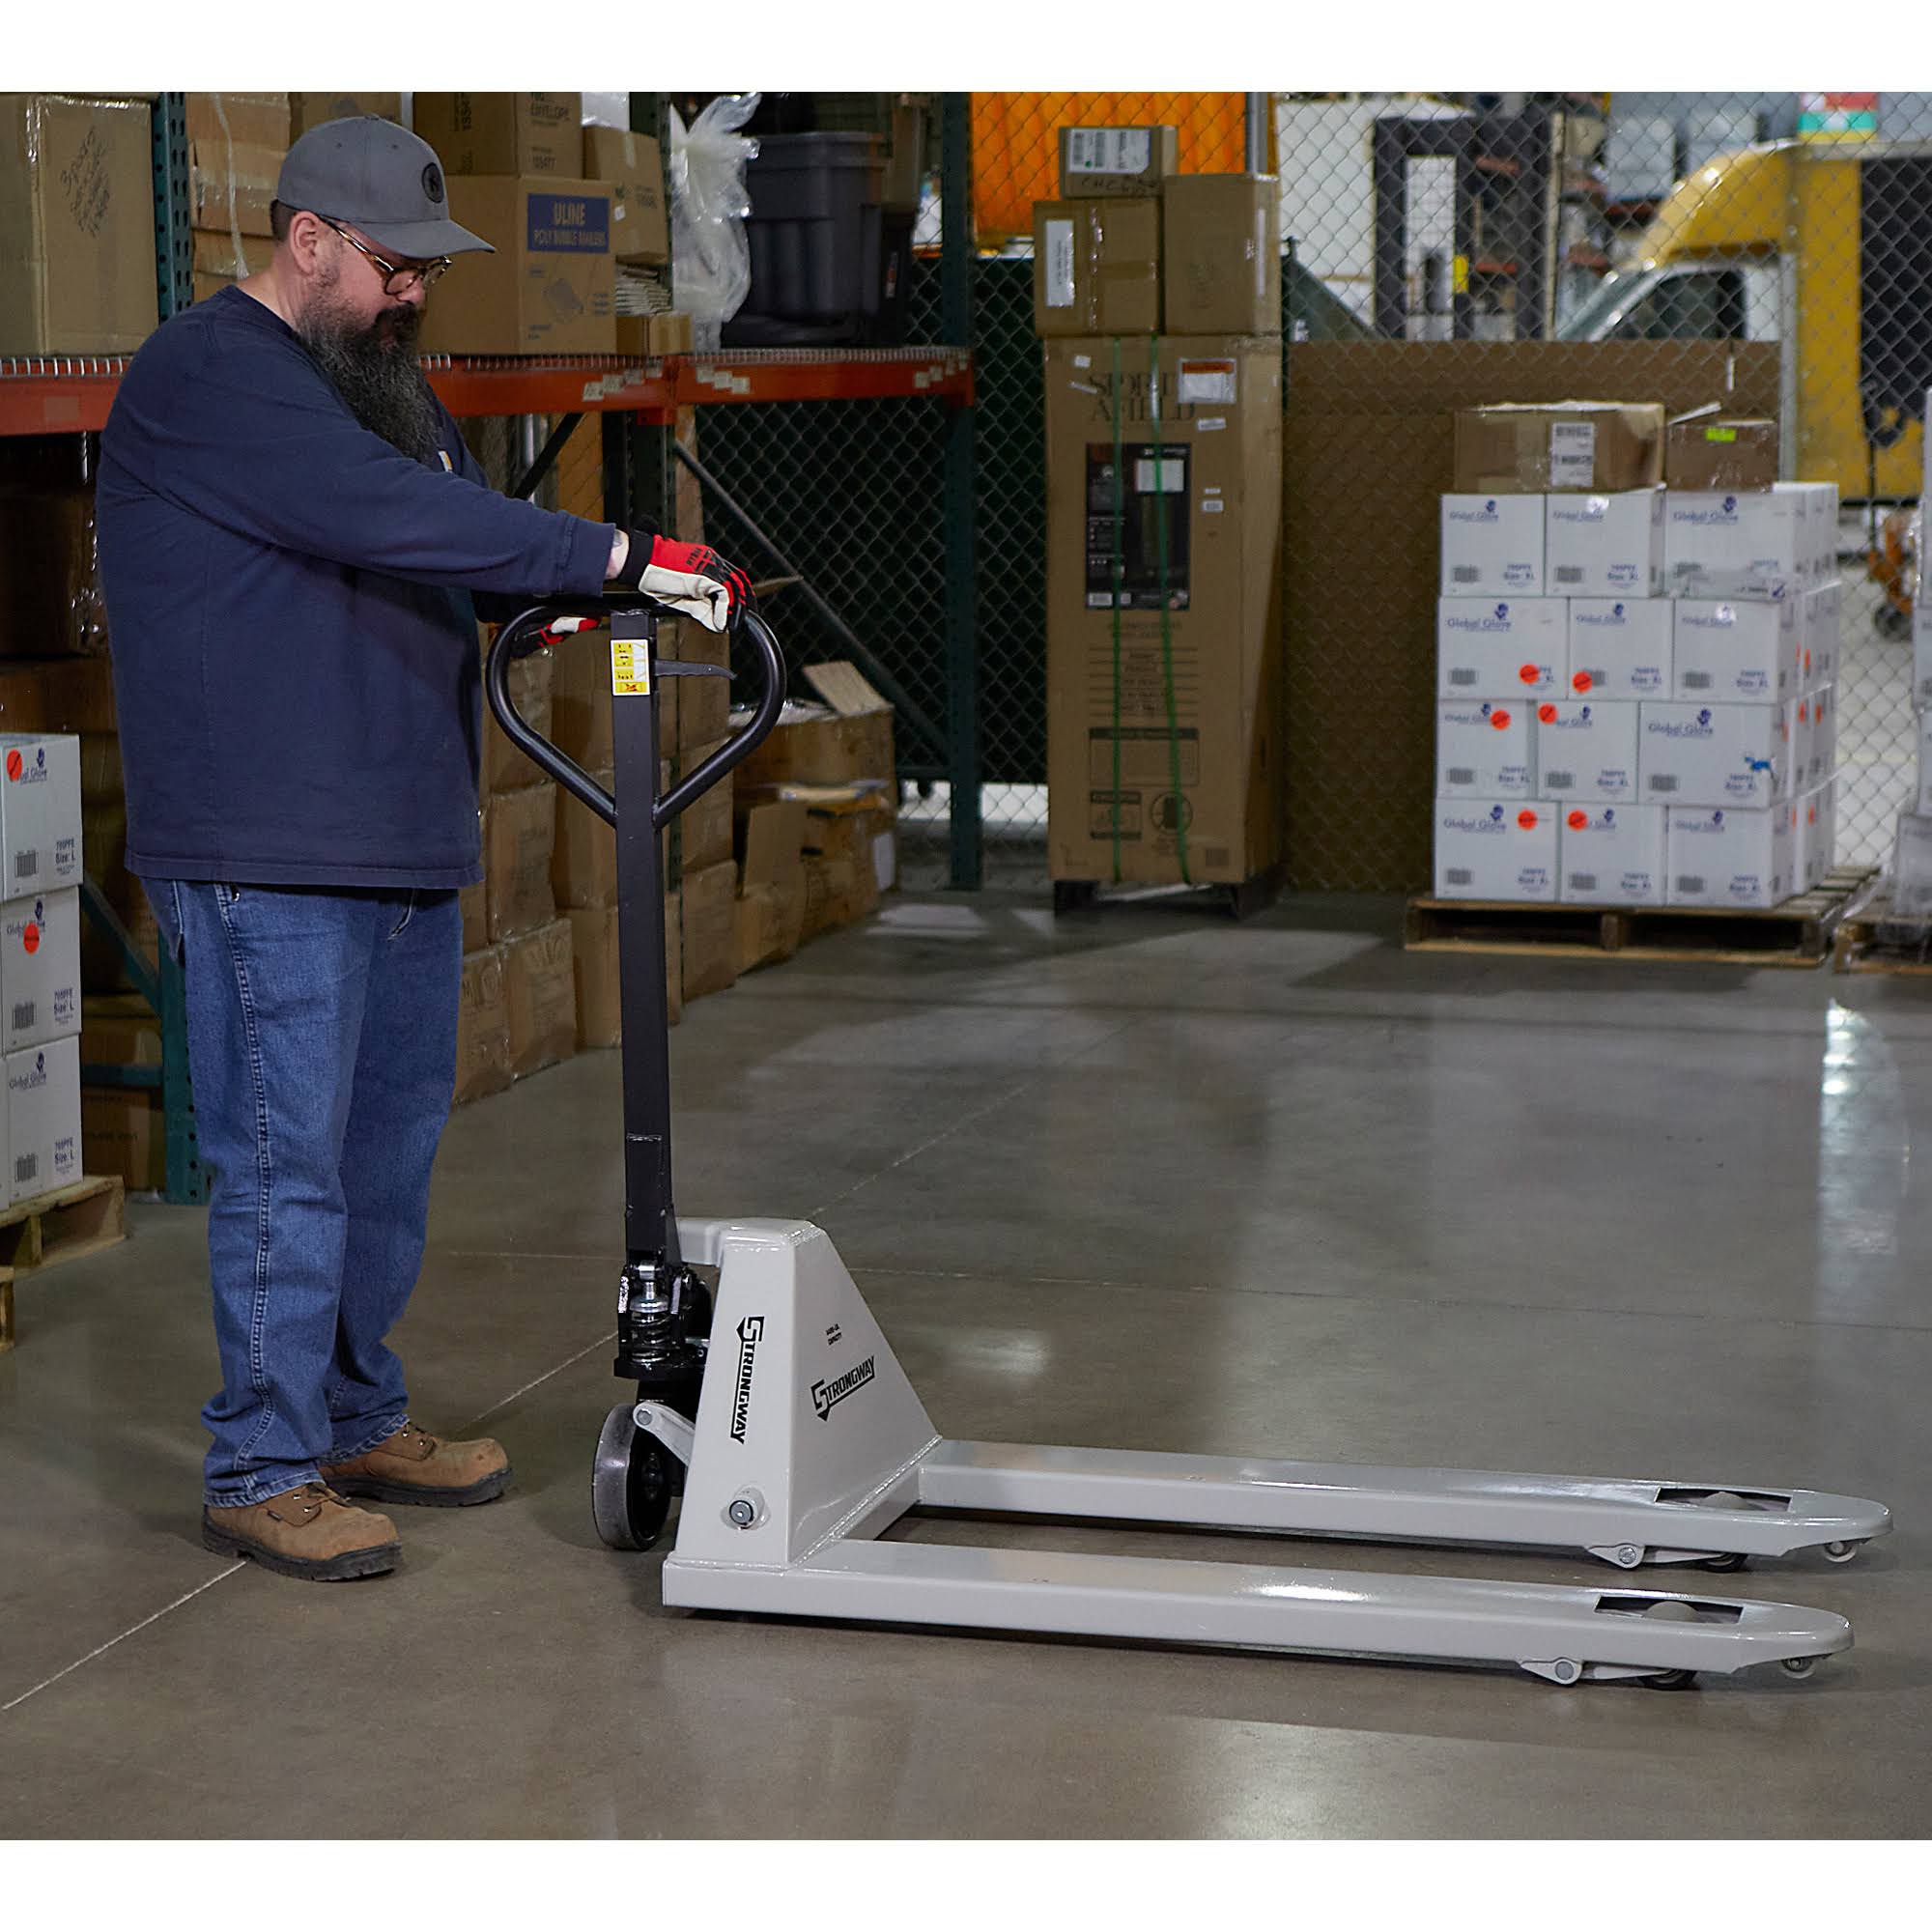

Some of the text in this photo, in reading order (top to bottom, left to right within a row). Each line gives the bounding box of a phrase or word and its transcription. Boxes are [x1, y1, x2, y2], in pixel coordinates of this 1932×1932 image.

[554, 201, 586, 226] ULINE
[1443, 818, 1507, 832] Global Glove
[71, 851, 76, 862] L
[70, 1000, 74, 1011] L
[70, 1150, 74, 1160] L
[730, 1316, 765, 1445] STRONGWAY
[810, 1354, 875, 1422] STRONGWAY
